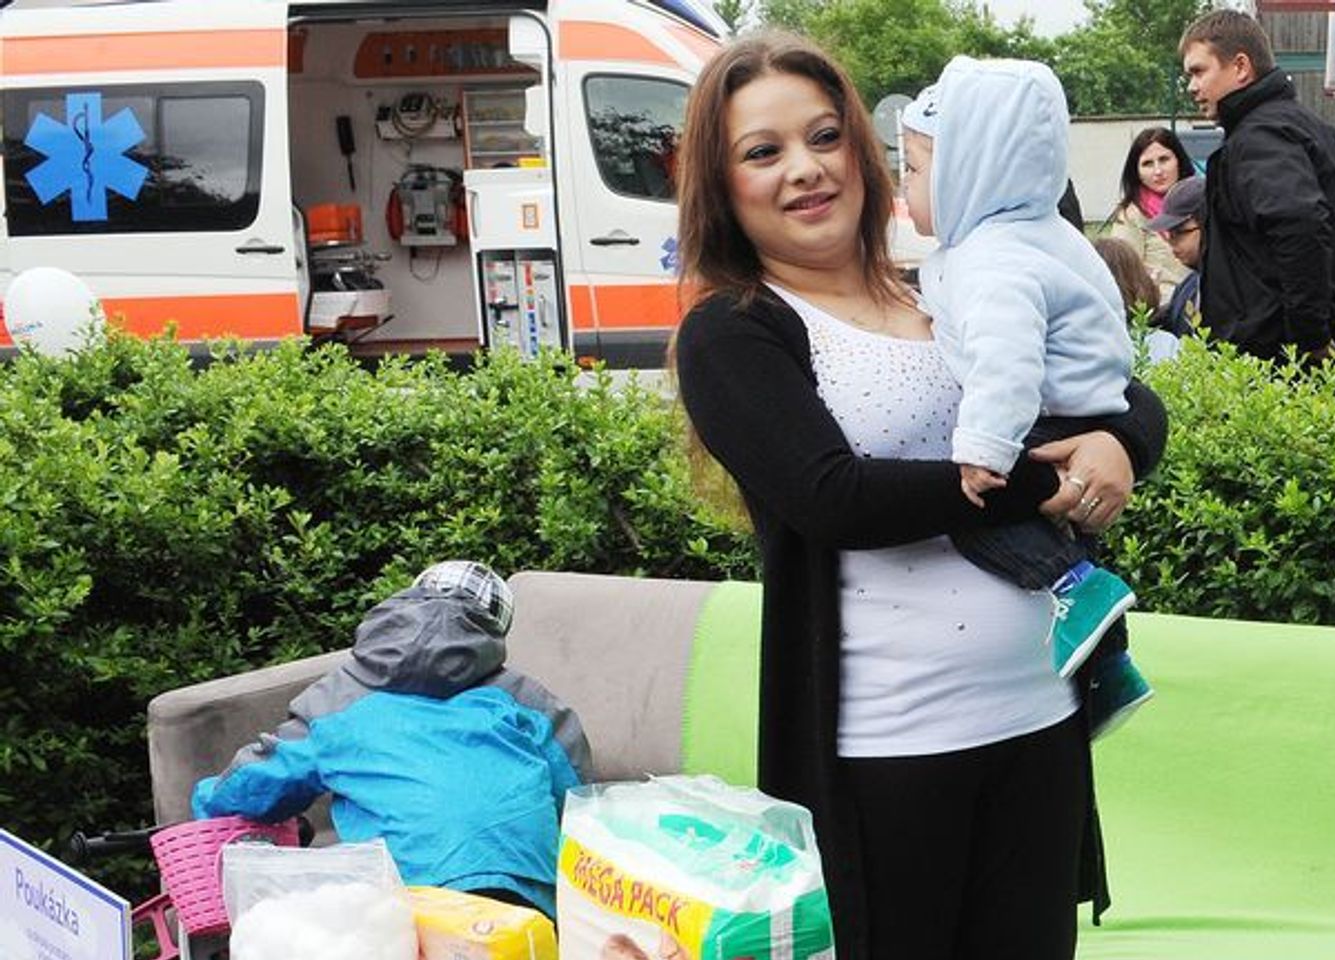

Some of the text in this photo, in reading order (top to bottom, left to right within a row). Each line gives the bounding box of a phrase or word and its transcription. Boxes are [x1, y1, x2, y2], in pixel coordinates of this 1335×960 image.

[15, 867, 80, 936] Poukázka
[573, 851, 687, 935] MEGA PACK
